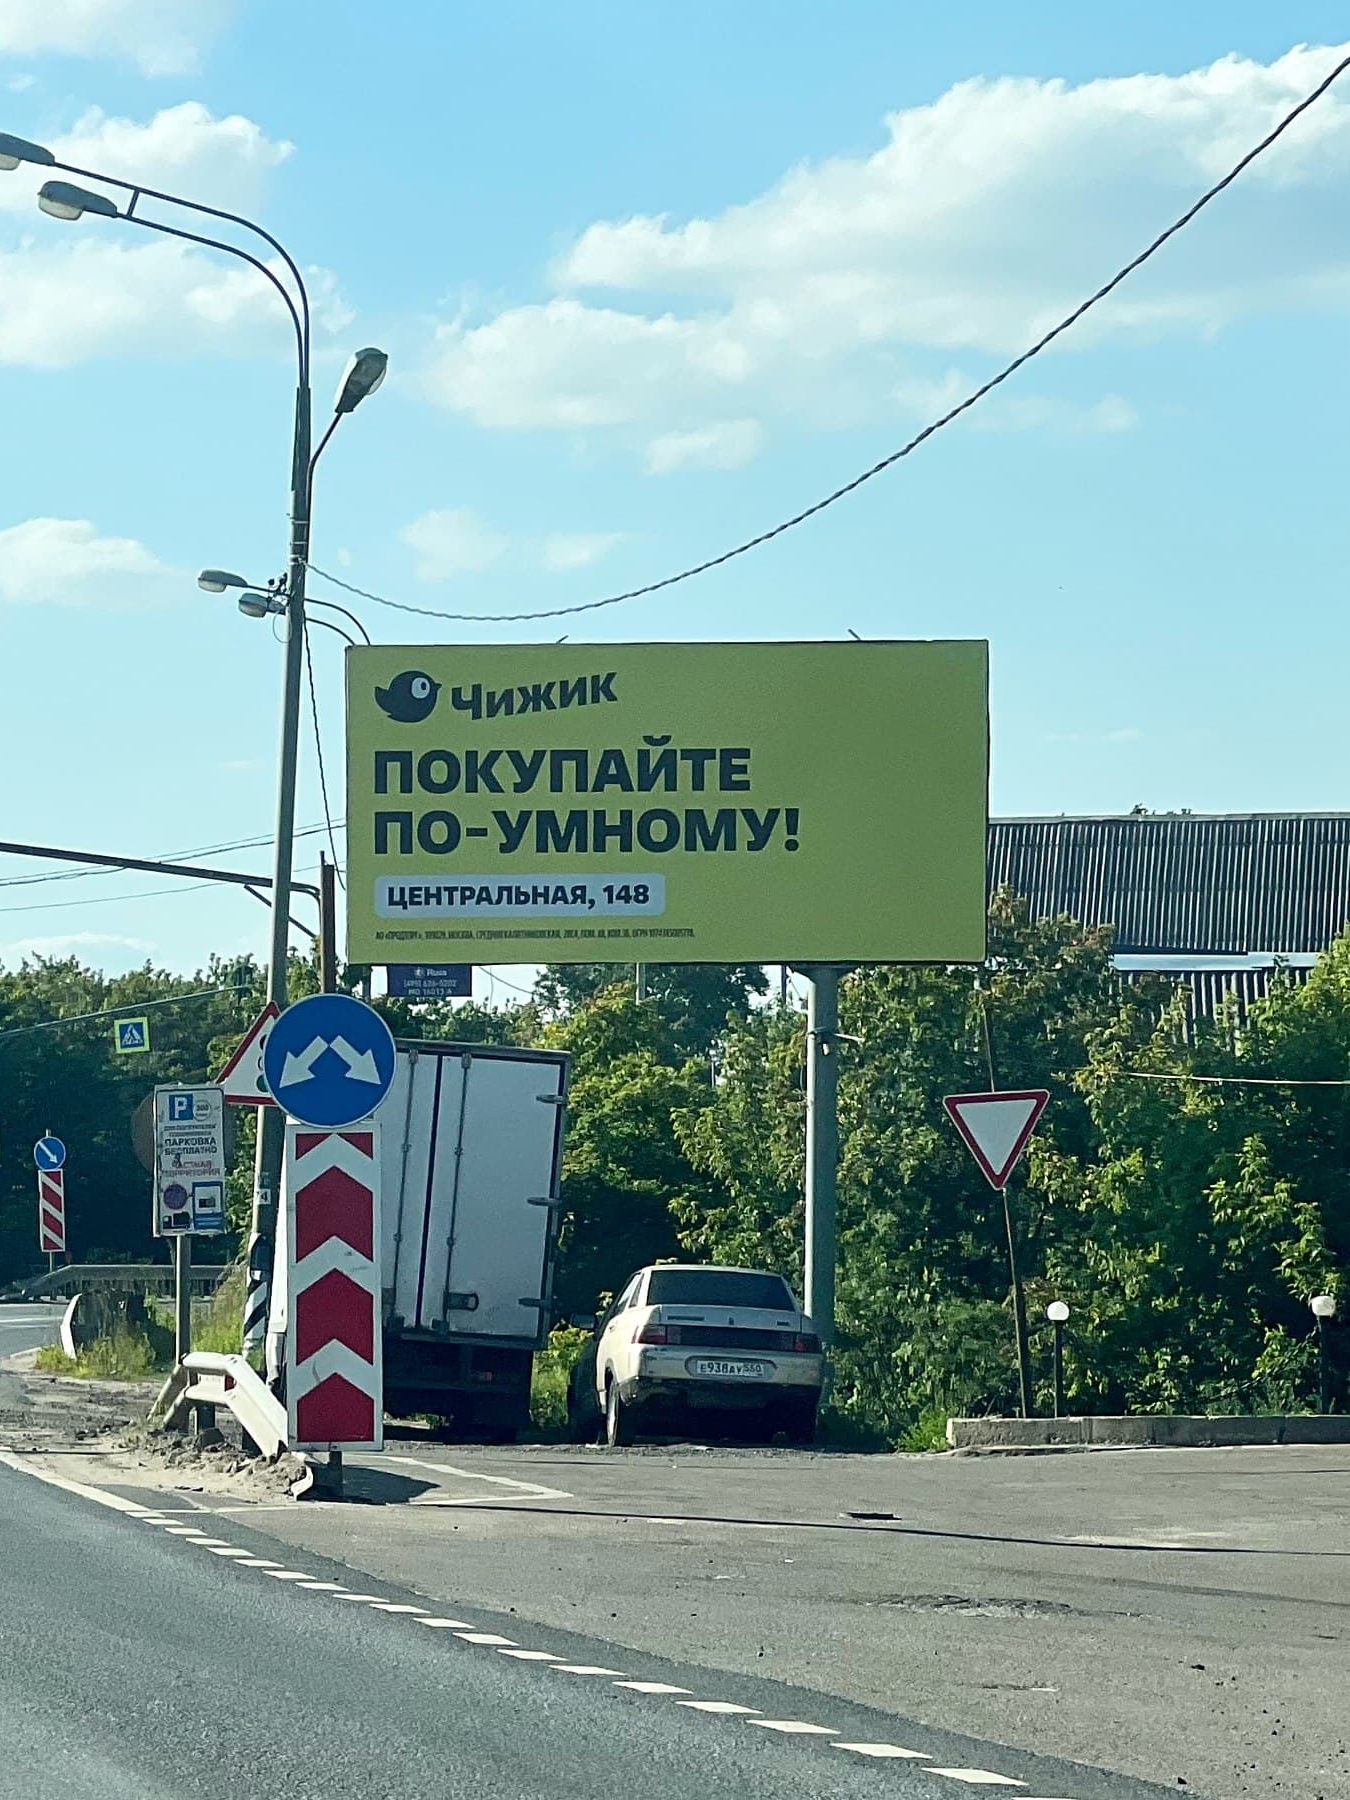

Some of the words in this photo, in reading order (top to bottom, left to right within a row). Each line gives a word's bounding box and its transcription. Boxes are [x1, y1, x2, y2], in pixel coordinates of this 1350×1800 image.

[374, 735, 752, 795] ПОКУПАЙТЕ
[374, 807, 801, 855] ПО-УМНОМУ!
[387, 885, 596, 910] ЦЕНТРАЛЬНАЯ,
[603, 884, 650, 905] 148
[174, 1096, 188, 1119] P
[164, 1137, 217, 1146] ПАРКОВКА
[164, 1146, 218, 1155] БЕСПЛАТНО
